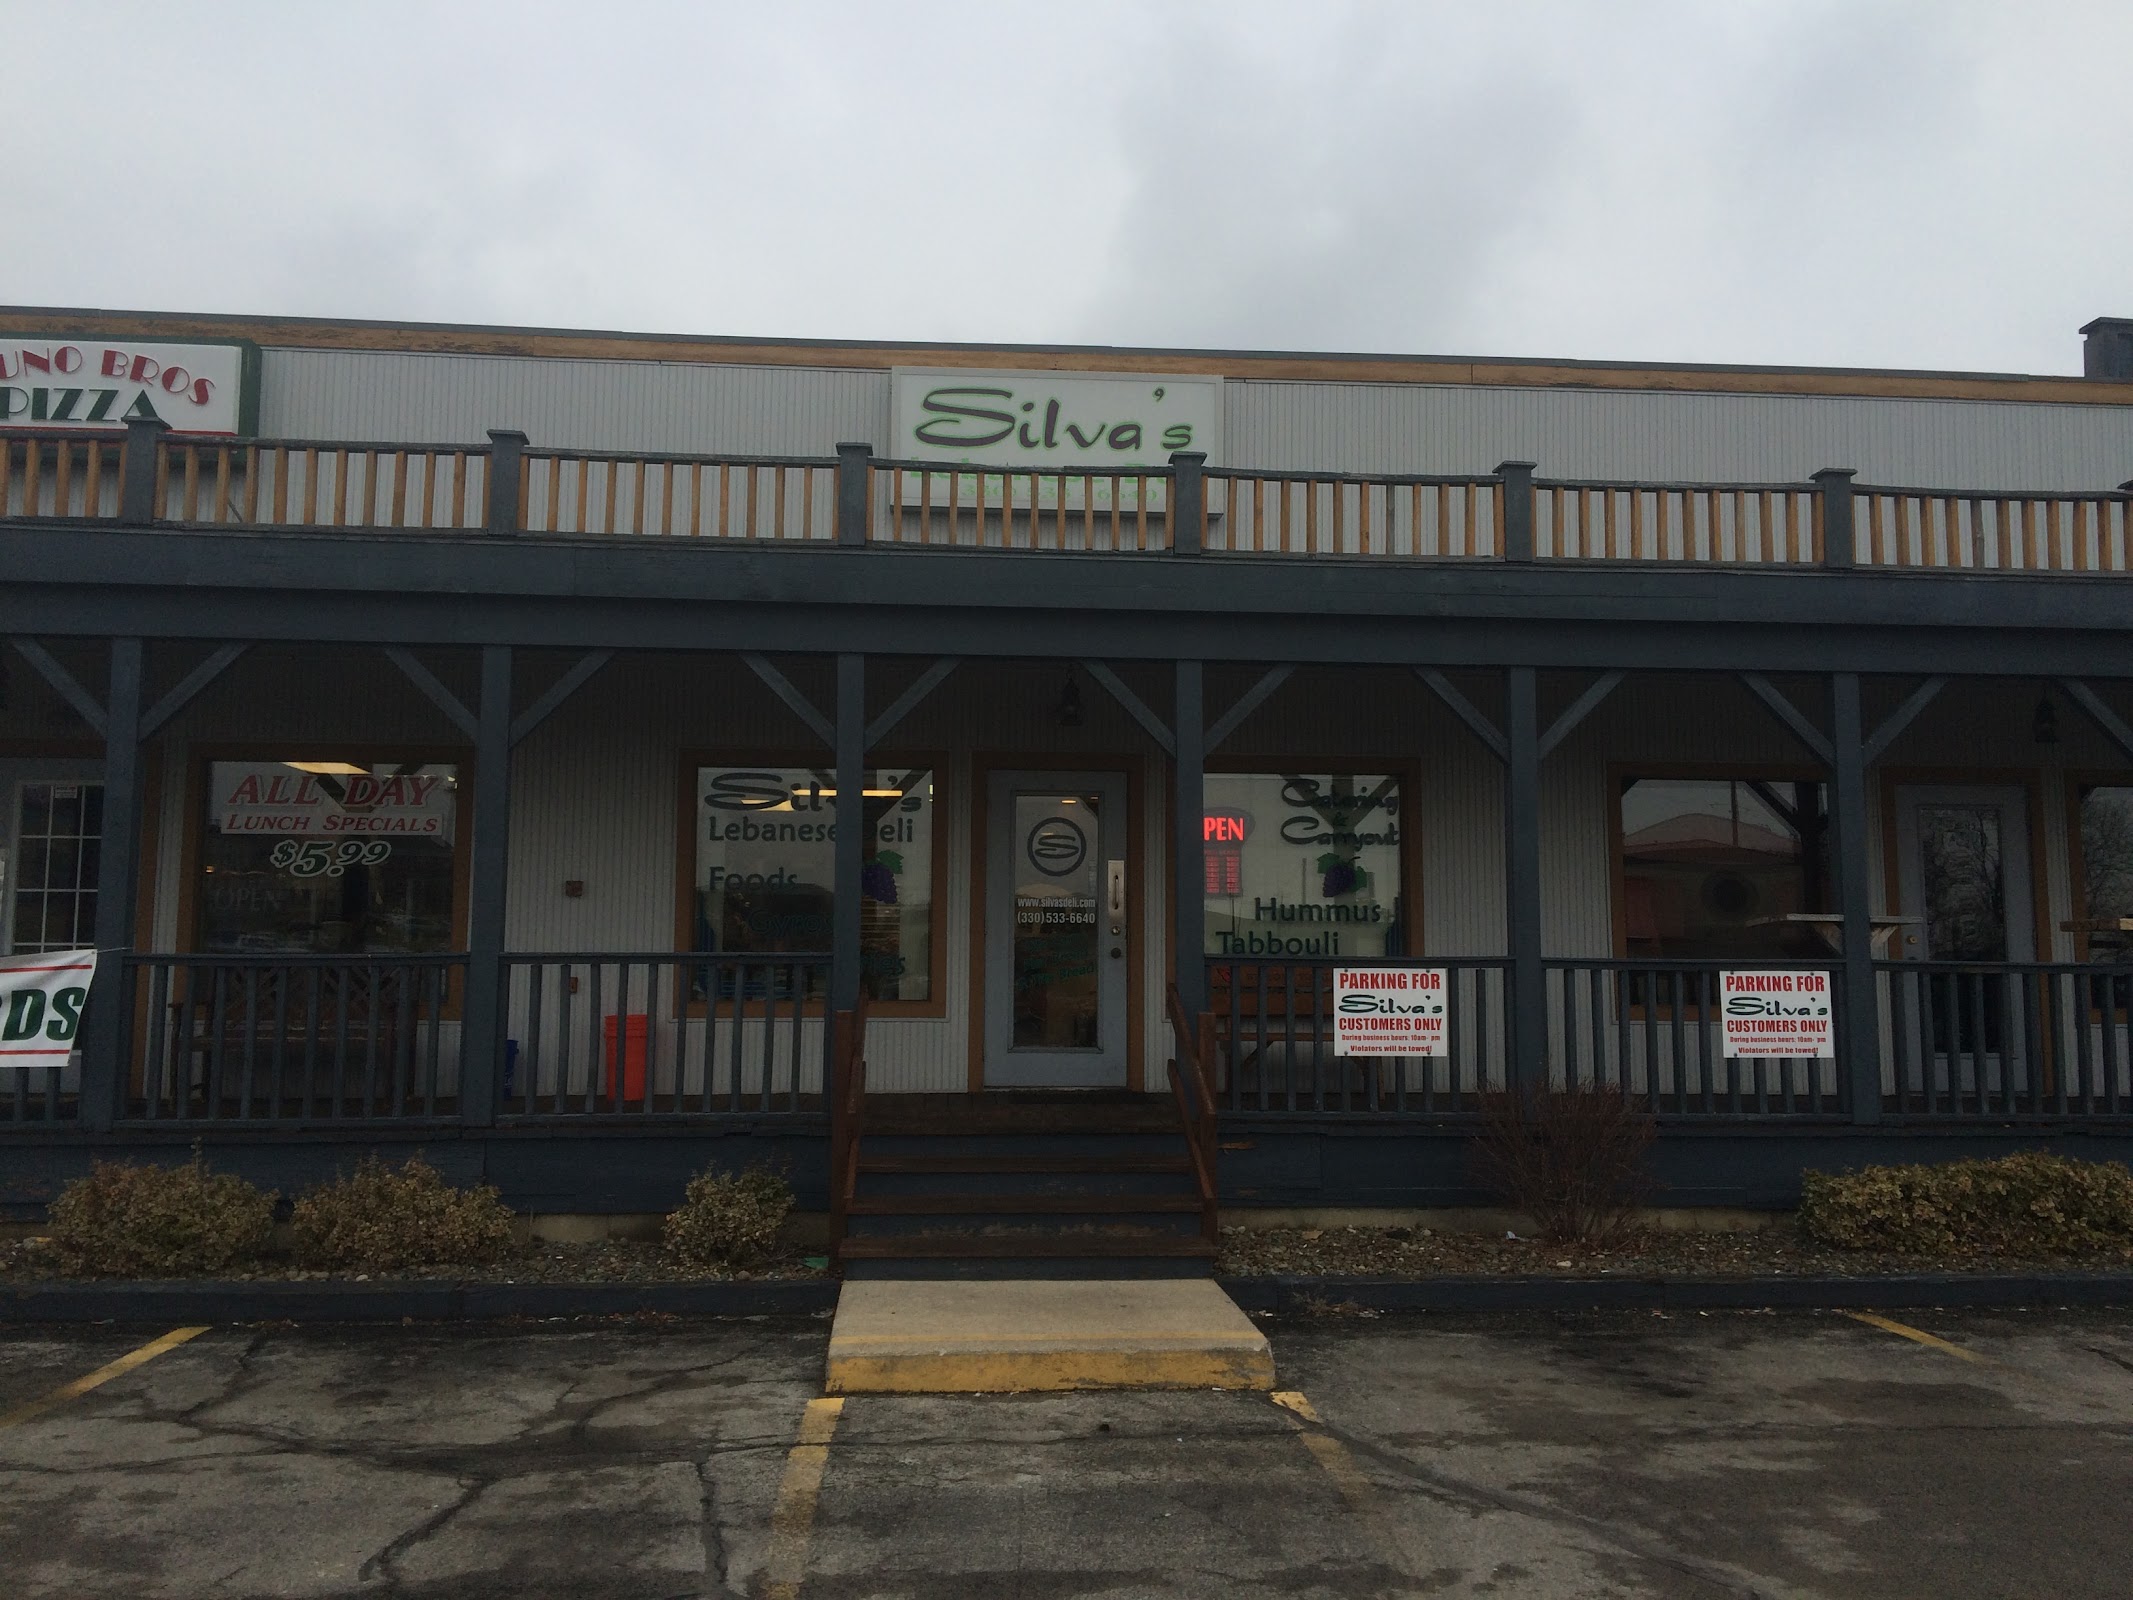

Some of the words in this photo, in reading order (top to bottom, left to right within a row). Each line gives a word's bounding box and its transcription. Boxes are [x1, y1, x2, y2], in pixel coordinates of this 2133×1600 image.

[100, 349, 217, 405] BROS
[0, 386, 159, 422] PIZZA
[914, 387, 1194, 450] Silva's
[227, 774, 321, 805] ALL
[344, 774, 440, 807] DAY
[704, 772, 922, 812] Sil's
[226, 813, 310, 831] LUNCH
[322, 814, 438, 832] SPECIALS
[708, 816, 837, 842] Lebanese
[863, 818, 913, 843] eli
[1203, 817, 1244, 841] PEN
[270, 839, 392, 878] $5.99
[709, 866, 798, 891] Foods
[1017, 897, 1096, 908] www.silvasdeli.com
[1255, 897, 1381, 922] Hummus
[1046, 912, 1096, 924] 533-6640
[1215, 931, 1340, 955] Tabbouli
[1339, 973, 1407, 989] PARKING
[1412, 973, 1441, 989] FOR
[1726, 975, 1792, 992] PARKING
[1797, 975, 1825, 992] FOR
[0, 987, 86, 1041] DS
[1338, 994, 1443, 1013] Silva's
[1726, 997, 1828, 1015] Silva's
[1338, 1018, 1411, 1031] CUSTOMERS
[1414, 1018, 1442, 1031] ONLY
[1727, 1020, 1797, 1033] CUSTOMERS
[1800, 1020, 1828, 1033] ONLY
